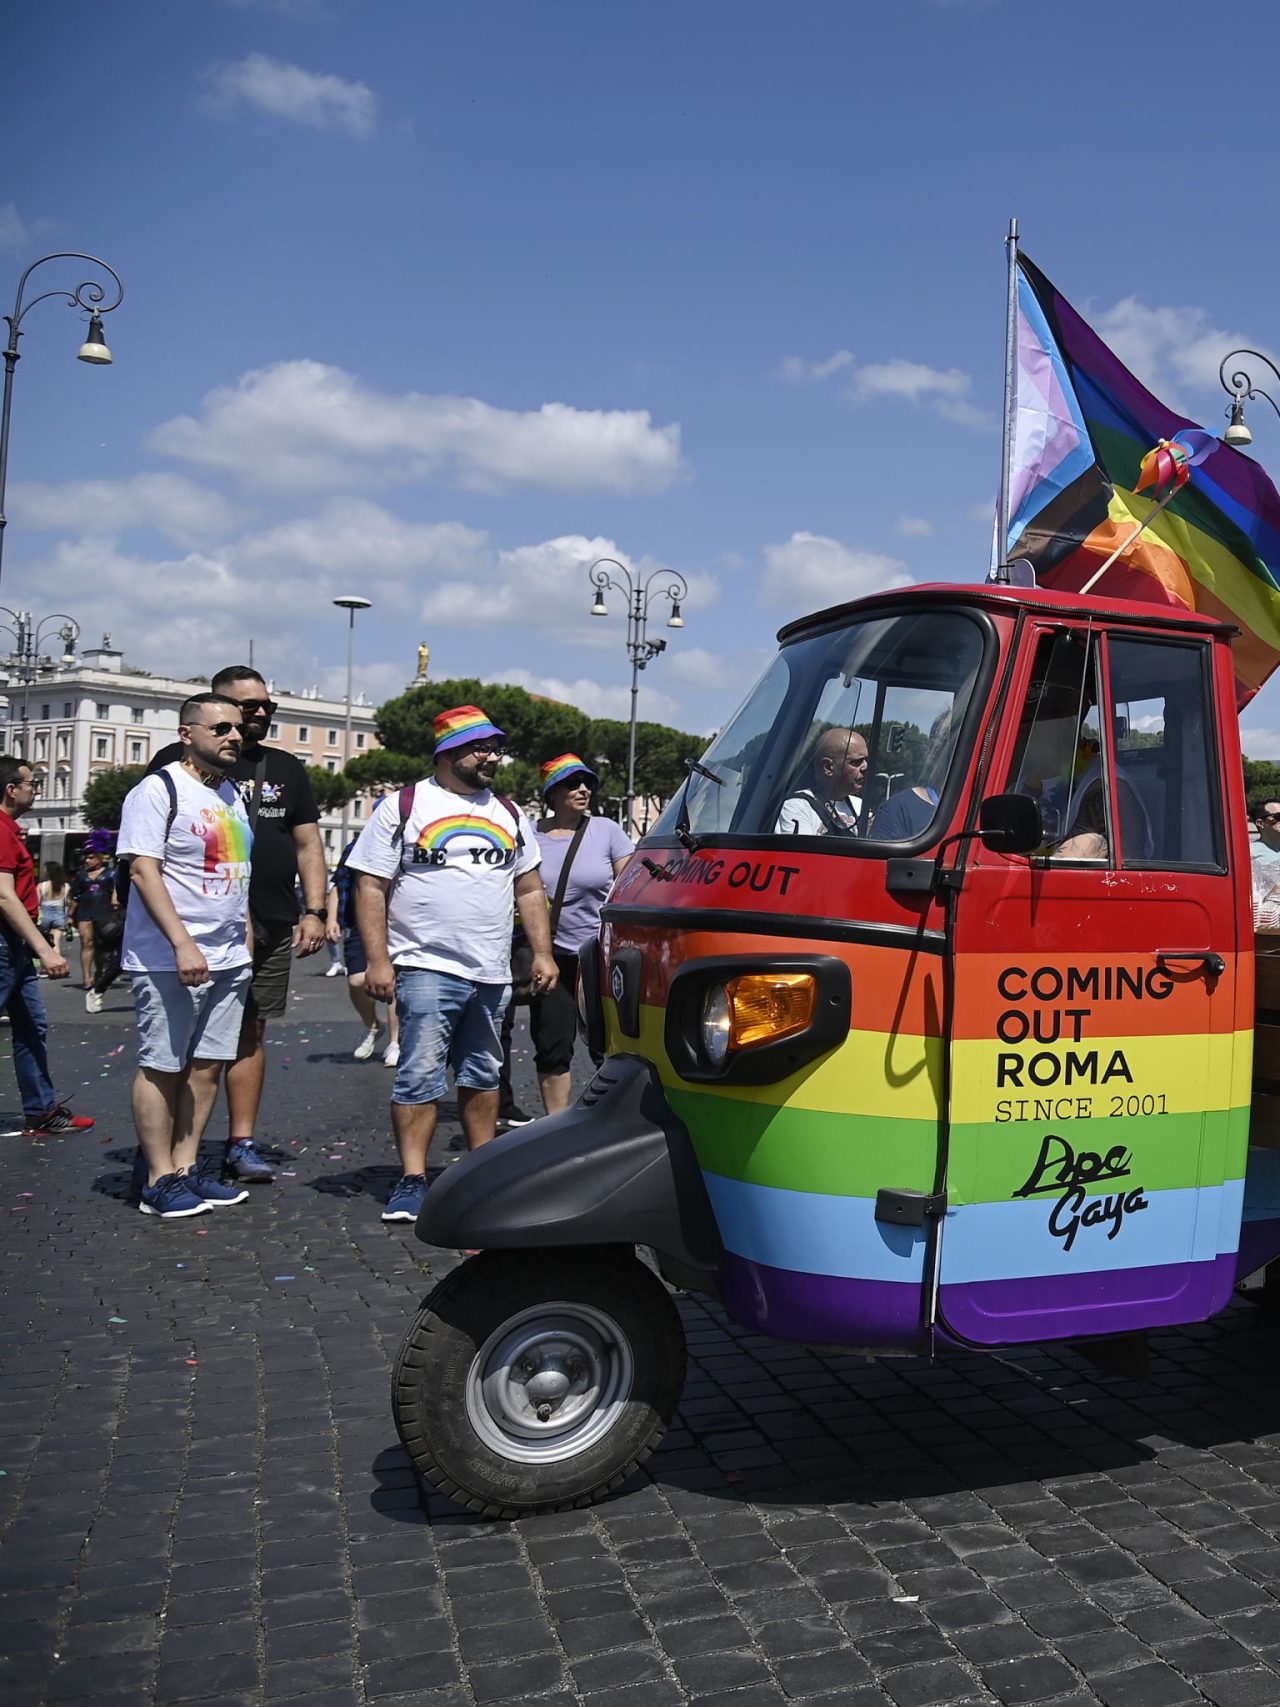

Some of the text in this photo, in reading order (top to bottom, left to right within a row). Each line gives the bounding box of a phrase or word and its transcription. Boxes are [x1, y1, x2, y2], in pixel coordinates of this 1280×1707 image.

[412, 847, 516, 865] BE YOU
[728, 861, 800, 896] OUT
[997, 965, 1174, 1001] COMING
[996, 1008, 1092, 1045] OUT
[996, 1050, 1134, 1088] ROMA
[995, 1093, 1169, 1123] SINCE 2001
[1010, 1134, 1134, 1198] Ape
[1048, 1184, 1149, 1252] Gaya
